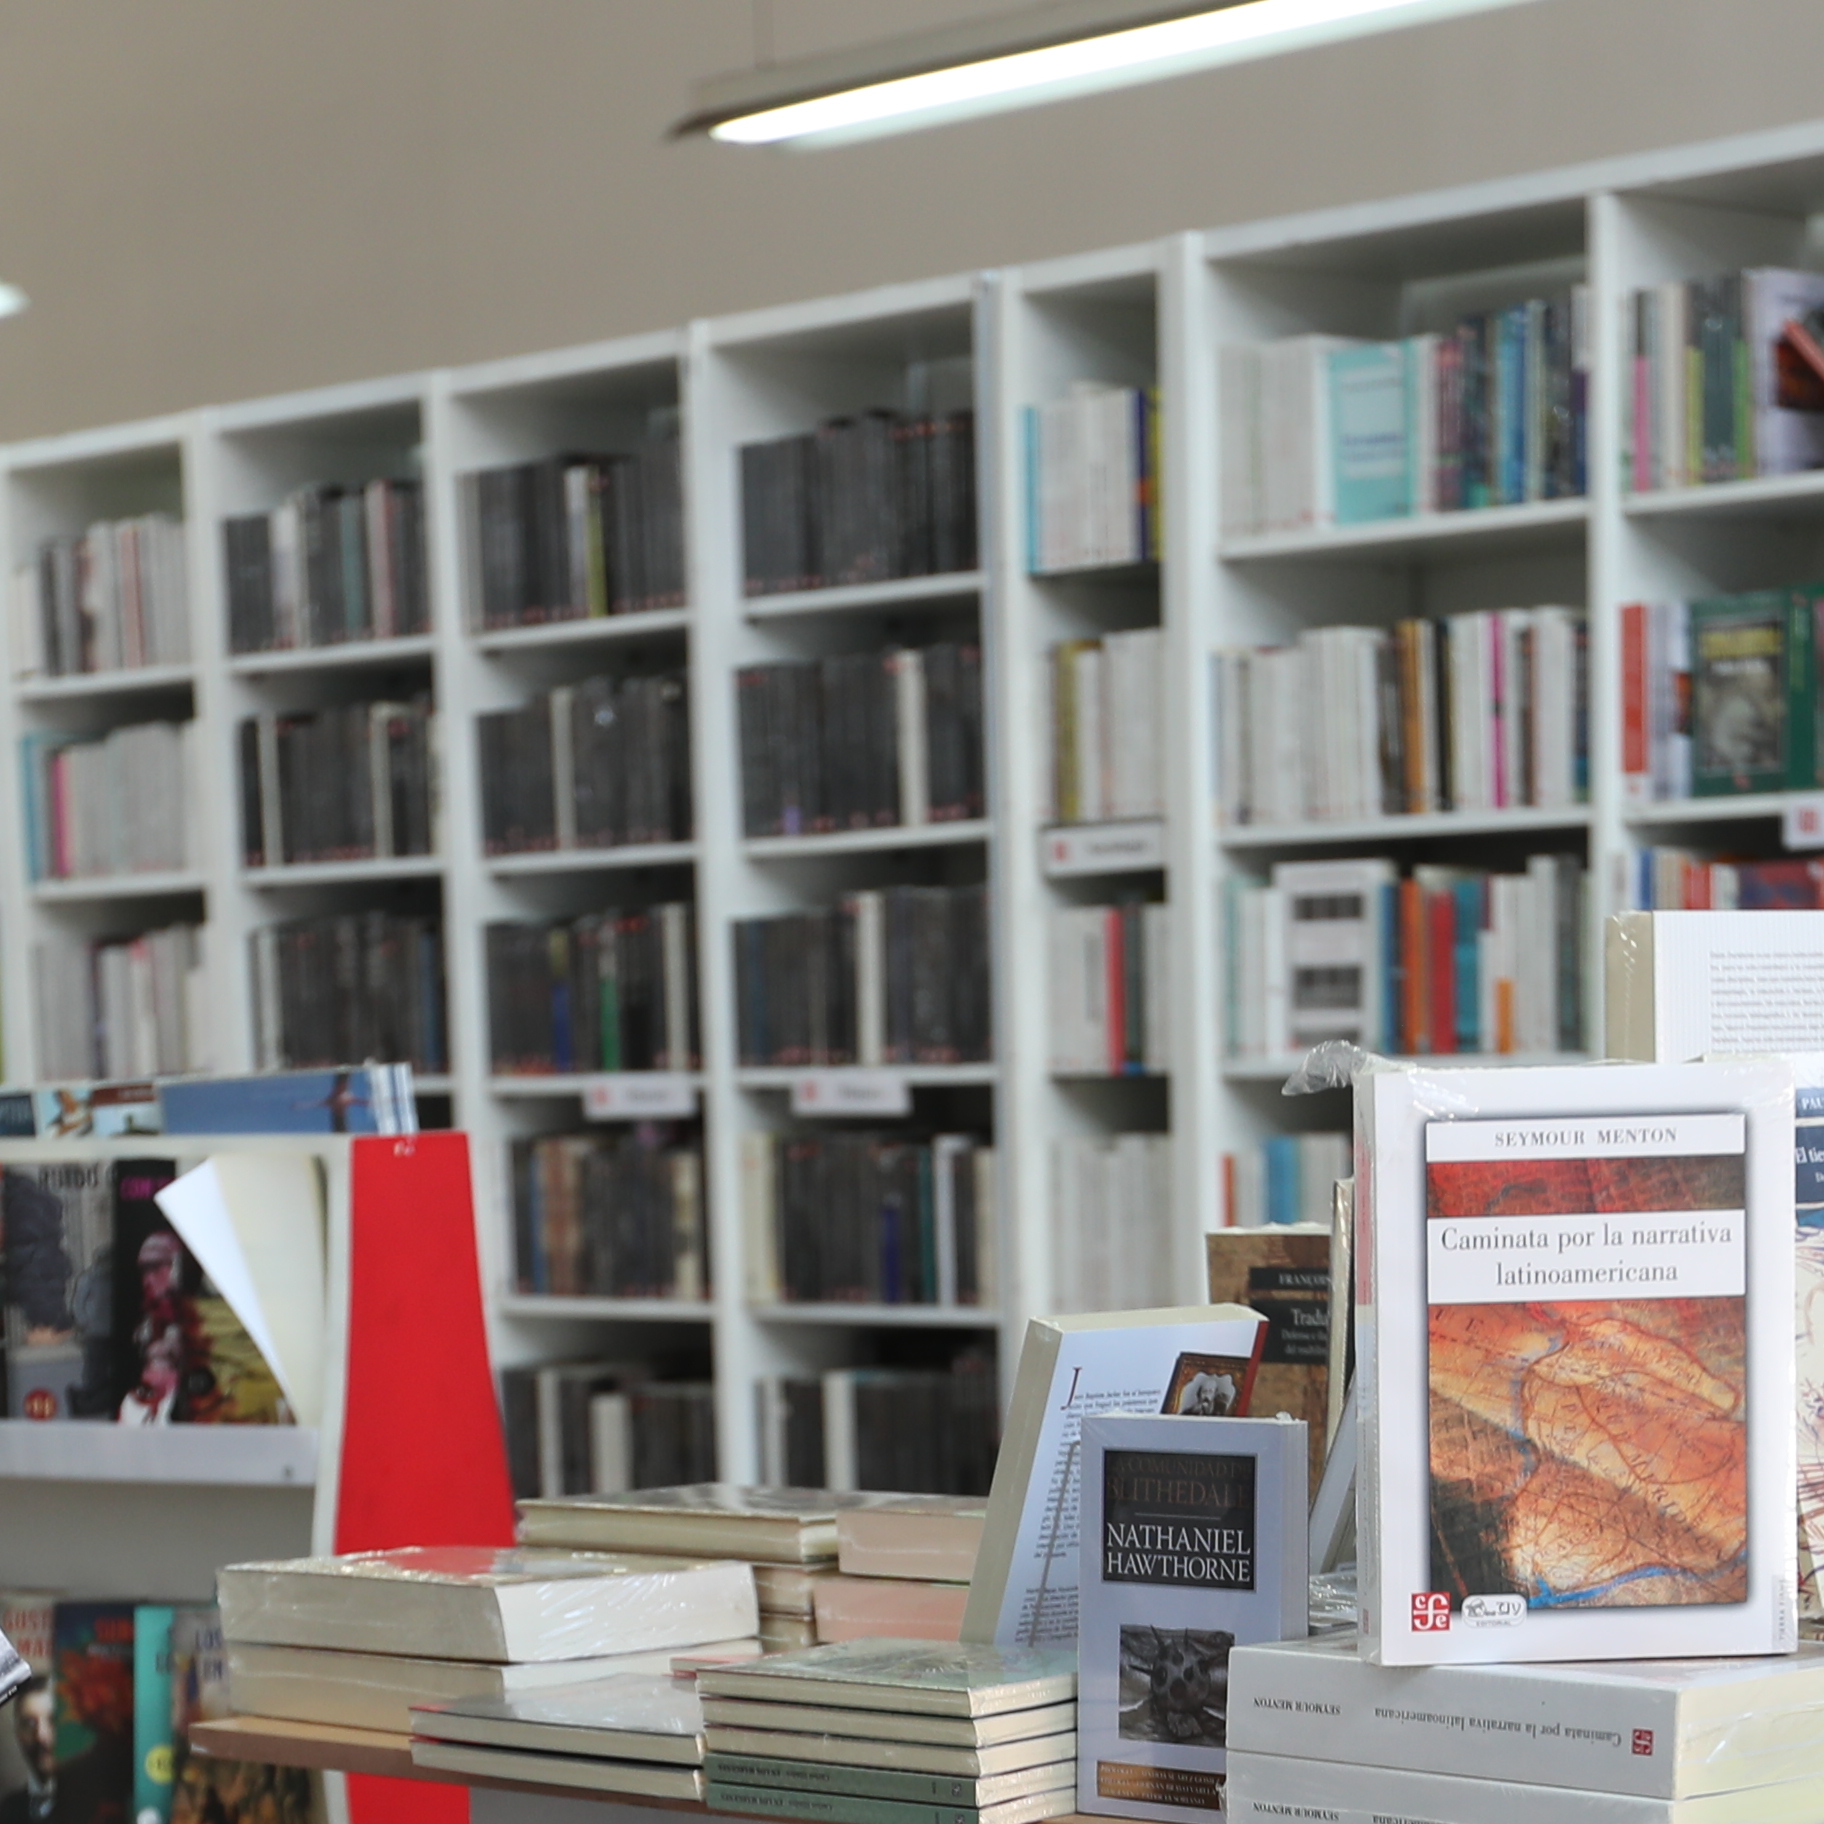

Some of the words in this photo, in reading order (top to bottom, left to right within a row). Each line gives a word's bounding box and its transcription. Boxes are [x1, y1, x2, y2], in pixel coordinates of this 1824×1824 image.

[1494, 1130, 1586, 1149] SEYMOUR
[1596, 1127, 1678, 1147] MENTON
[1440, 1227, 1549, 1252] Caminata
[1557, 1229, 1595, 1254] por
[1602, 1223, 1624, 1247] la
[1631, 1224, 1732, 1247] narrativa
[1495, 1260, 1678, 1287] latinoamericana
[1107, 1522, 1251, 1555] NATHANIEL
[1107, 1552, 1251, 1582] HAWTHORNE
[1252, 1697, 1292, 1712] MENTON
[1293, 1700, 1341, 1717] SEYMOUR
[1374, 1706, 1466, 1731] latinoamericana
[1468, 1716, 1522, 1736] narrativa
[1524, 1724, 1537, 1738] la
[1539, 1723, 1561, 1739] por
[1563, 1726, 1622, 1748] Caminata
[1251, 1801, 1292, 1817] MENTON
[1293, 1806, 1340, 1823] SEYMOUR
